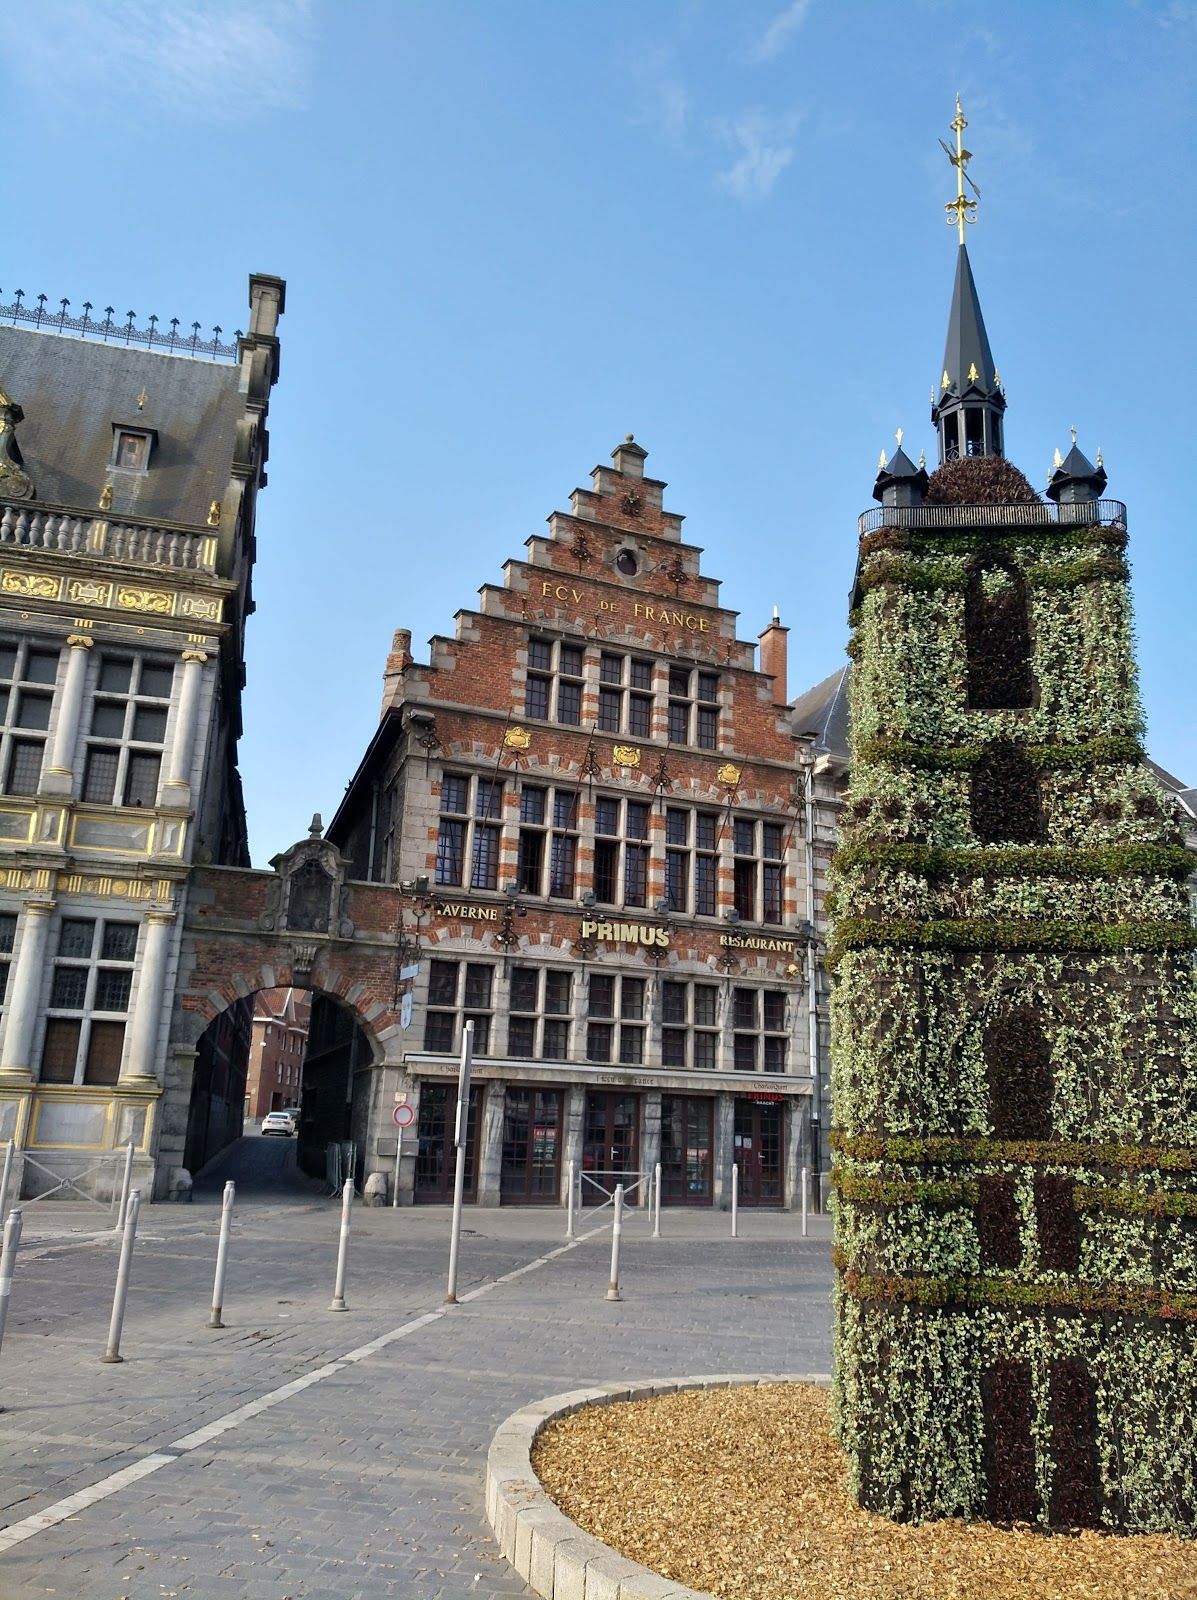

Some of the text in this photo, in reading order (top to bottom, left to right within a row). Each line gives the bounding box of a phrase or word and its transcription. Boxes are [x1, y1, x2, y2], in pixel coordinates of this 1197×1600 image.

[541, 582, 711, 633] ECV DE FRANCE
[582, 920, 670, 947] PRIMUS
